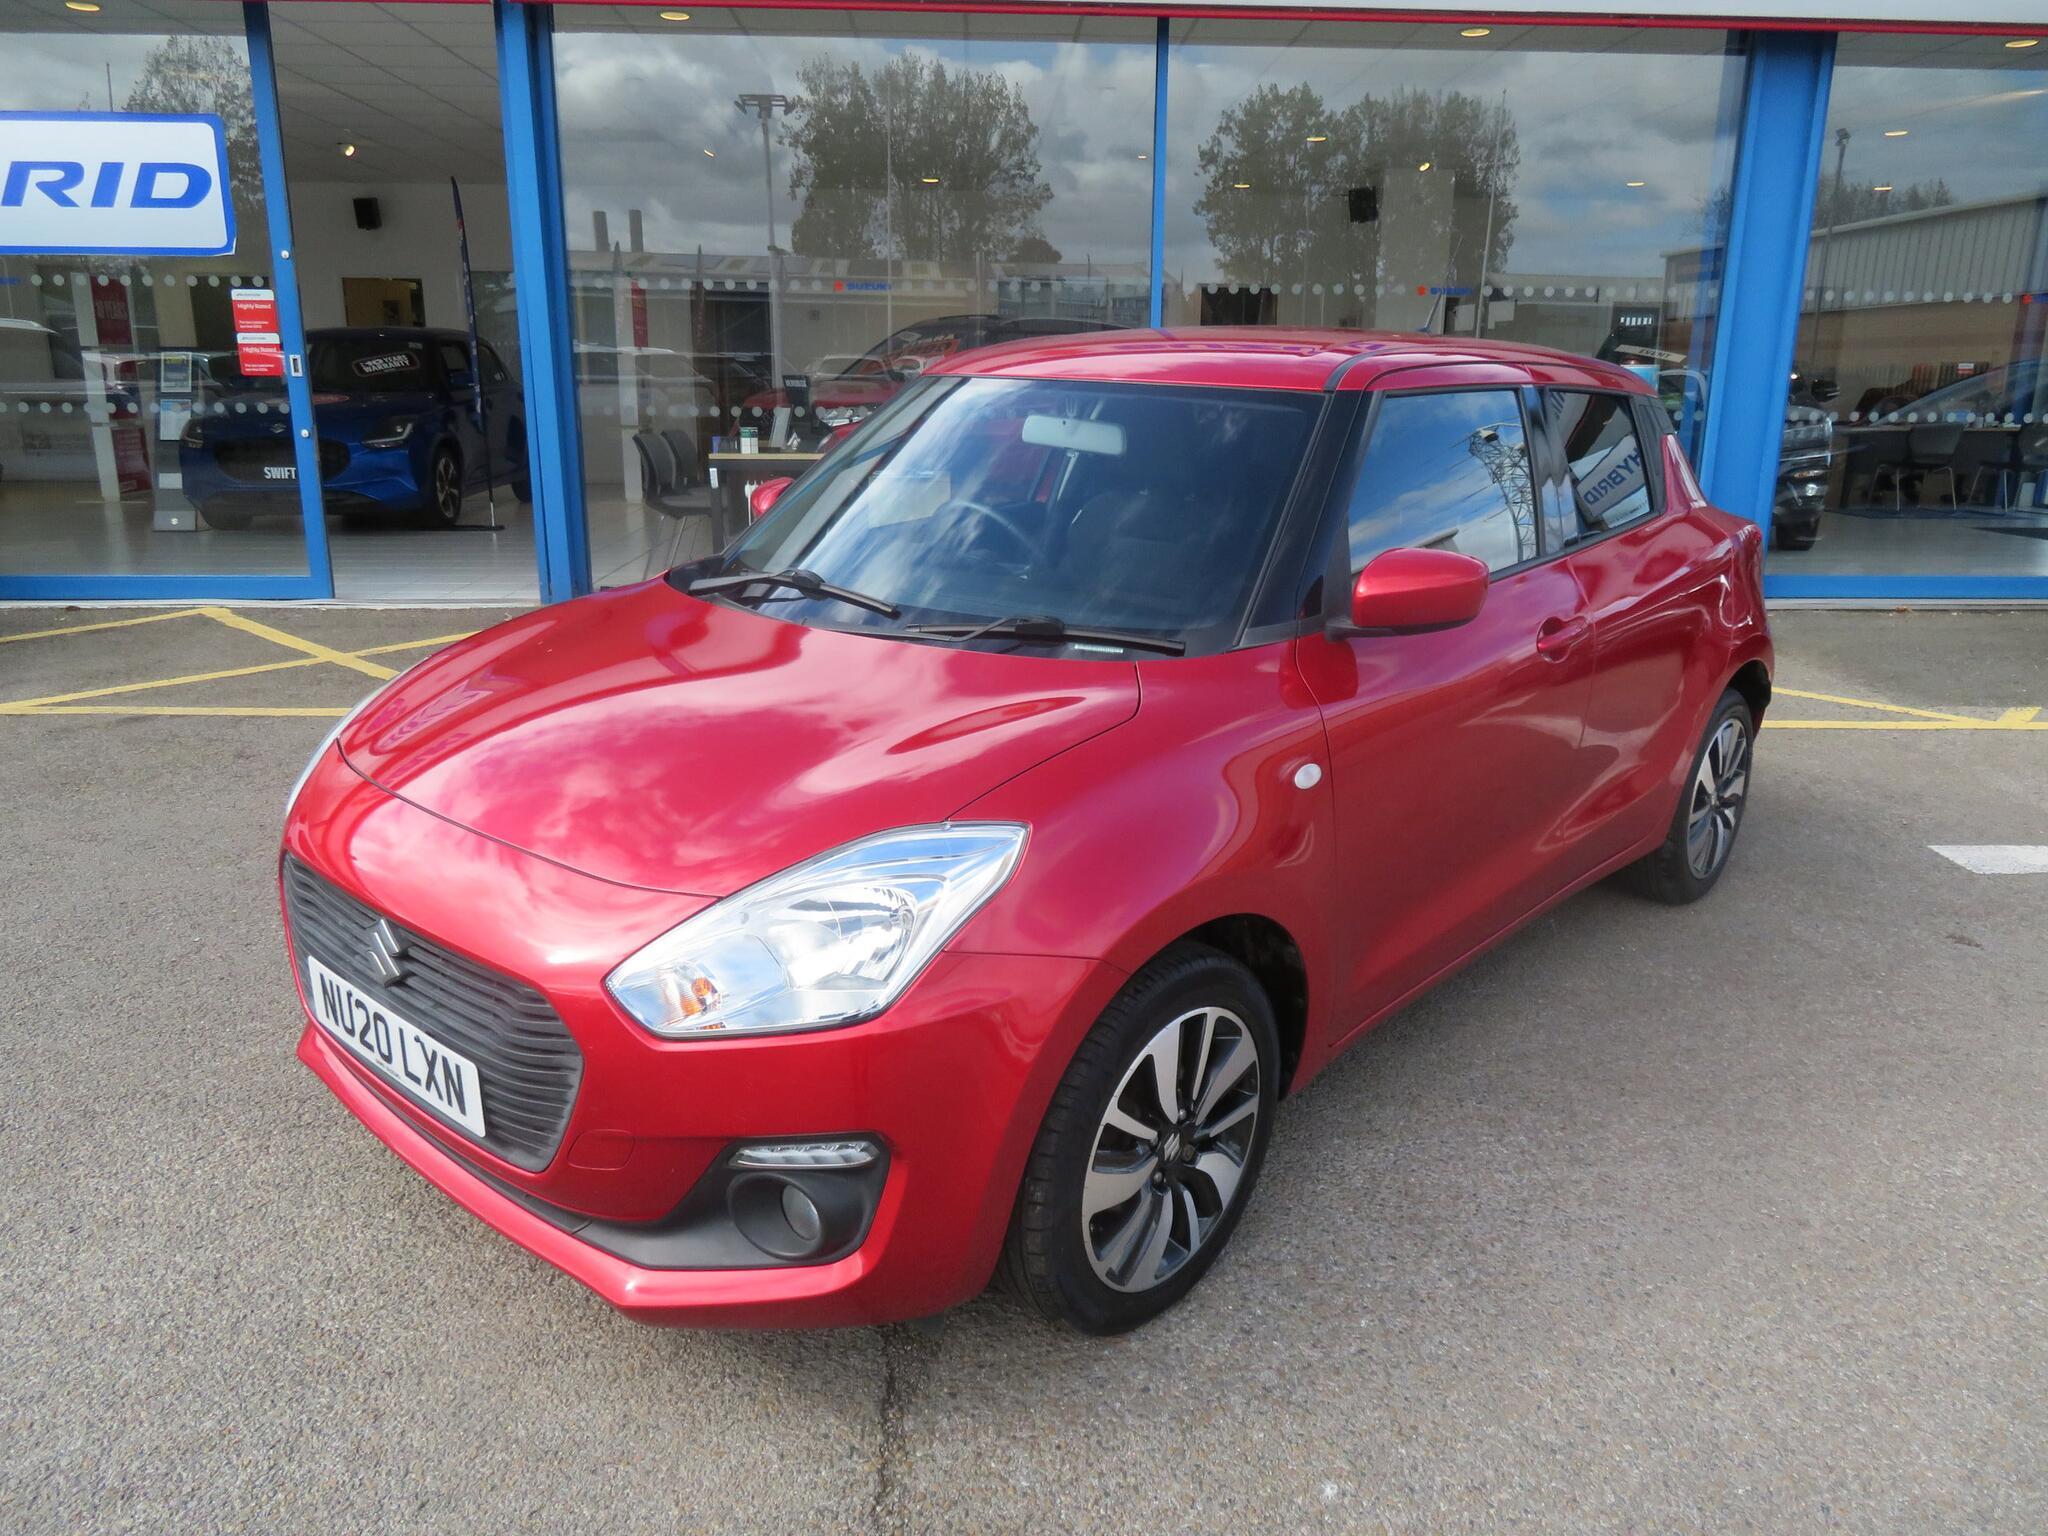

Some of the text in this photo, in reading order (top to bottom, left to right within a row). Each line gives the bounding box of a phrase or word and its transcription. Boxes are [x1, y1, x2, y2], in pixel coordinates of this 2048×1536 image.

[1, 161, 212, 208] RID
[263, 466, 297, 480] SWIFT
[319, 972, 467, 1117] NU20 LXN
